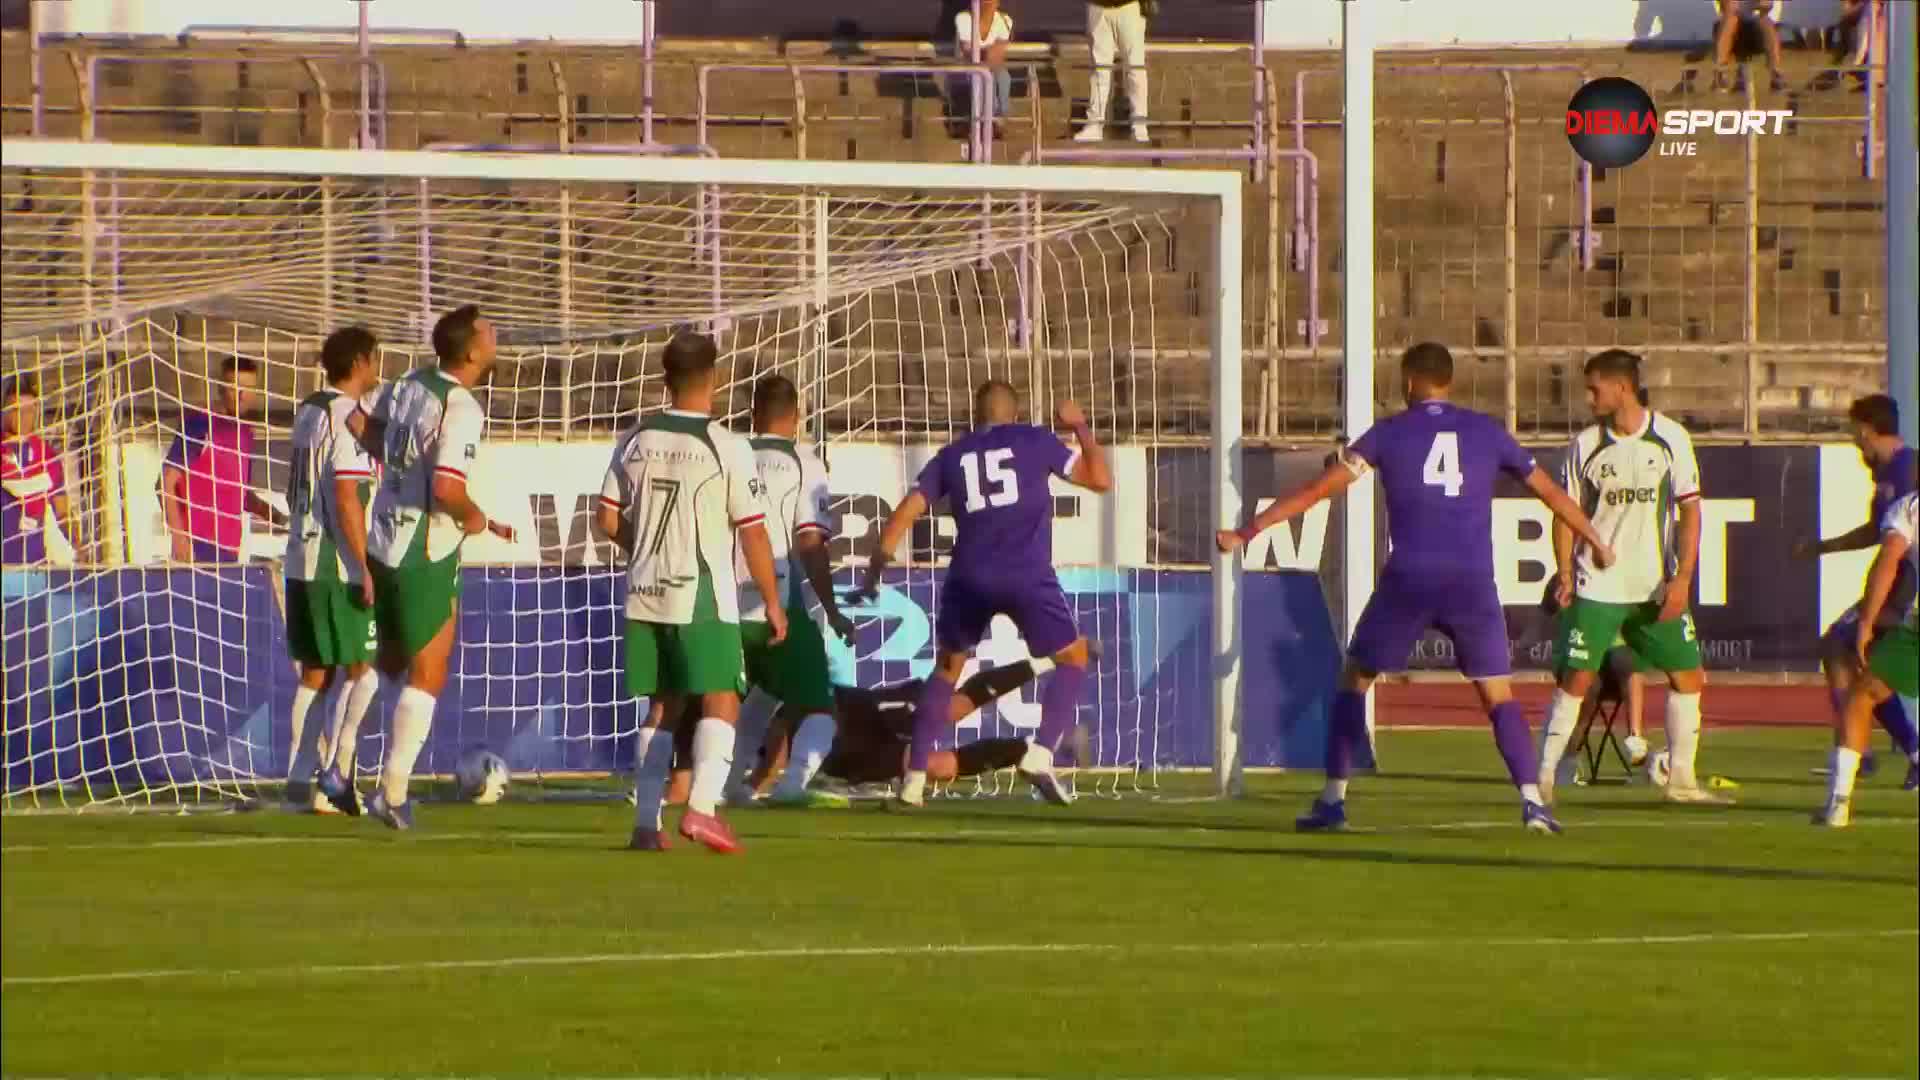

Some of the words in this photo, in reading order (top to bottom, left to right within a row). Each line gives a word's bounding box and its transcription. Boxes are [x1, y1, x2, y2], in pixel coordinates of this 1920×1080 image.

[959, 448, 1018, 513] 15
[1423, 431, 1463, 496] 4
[651, 478, 681, 555] 7
